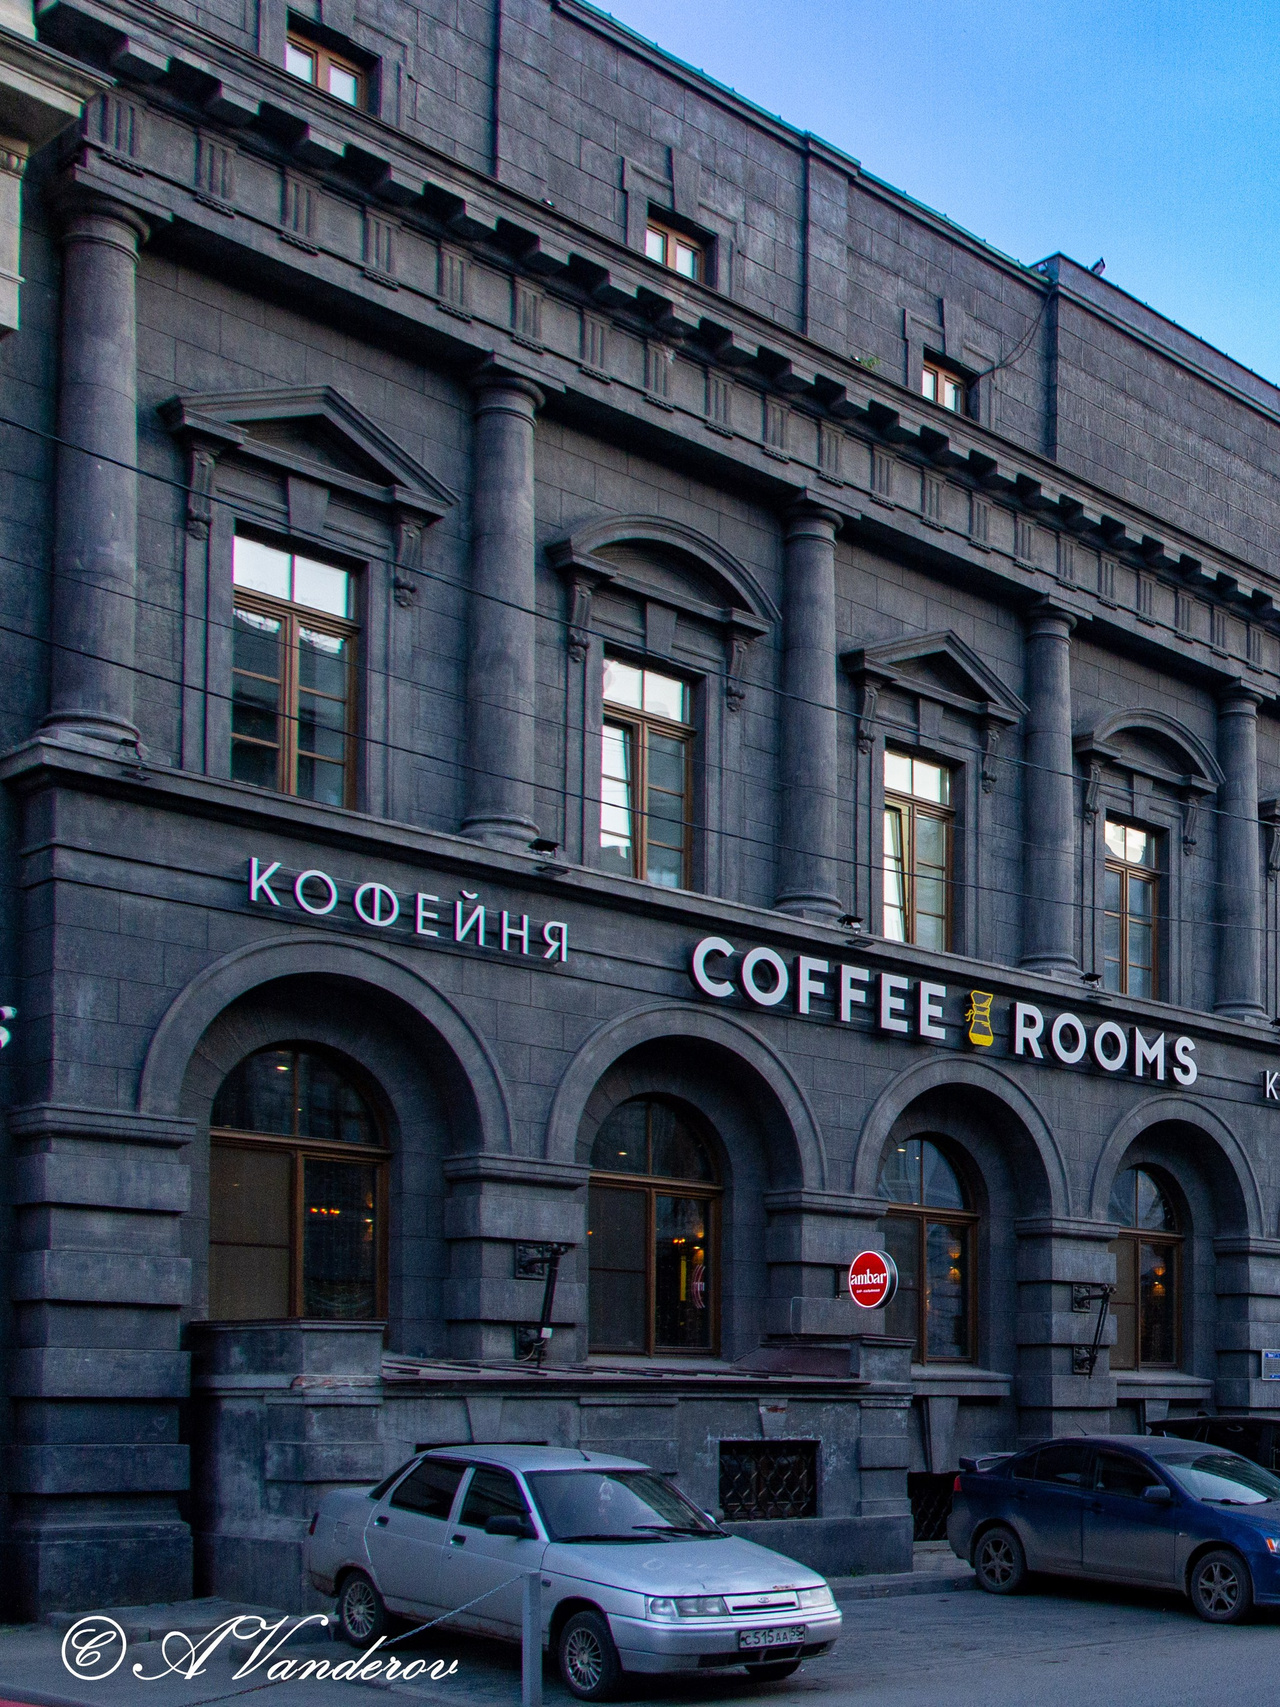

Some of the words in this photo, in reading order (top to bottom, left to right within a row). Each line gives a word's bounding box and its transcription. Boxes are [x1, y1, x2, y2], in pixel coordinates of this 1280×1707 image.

[250, 857, 568, 962] КОФЕЙНЯ
[692, 936, 946, 1040] COFFEE
[1014, 1002, 1198, 1085] ROOMS
[850, 1268, 887, 1285] ambar
